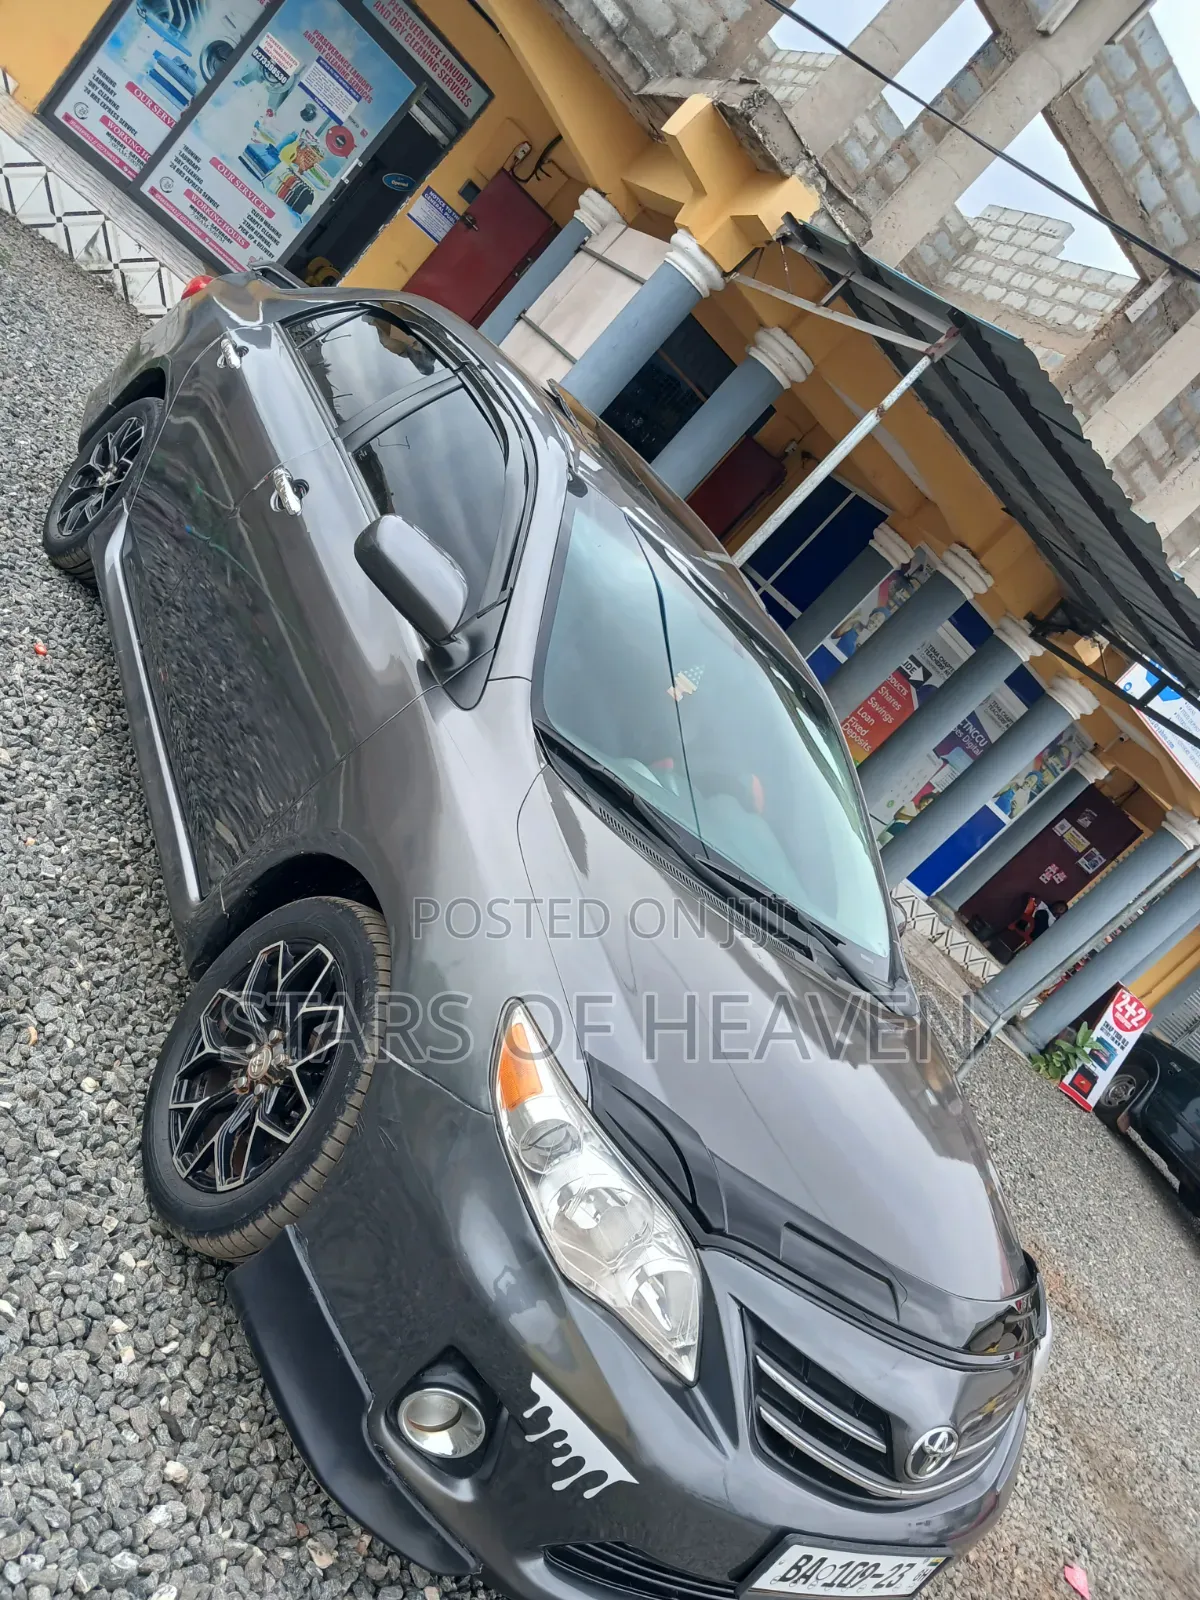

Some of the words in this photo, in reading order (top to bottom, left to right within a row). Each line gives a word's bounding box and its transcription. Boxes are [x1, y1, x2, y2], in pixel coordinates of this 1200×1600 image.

[387, 0, 443, 58] PERSEVERANCE
[265, 41, 273, 49] FOR
[311, 30, 352, 70] PERSEVERANCE
[373, 0, 393, 20] AND
[389, 17, 408, 36] DRY
[404, 33, 441, 73] CLEANING
[437, 69, 473, 108] SERVICES
[302, 30, 317, 45] AND
[313, 41, 327, 55] DRY
[324, 52, 351, 80] CLEANING
[347, 77, 375, 104] SERVICES
[97, 89, 121, 111] CLEANING
[133, 89, 154, 108] OUR
[99, 101, 120, 120] EXPRESS
[118, 118, 138, 136] SERVICE
[106, 120, 143, 154] WORKING
[106, 131, 127, 150] MONDAY
[182, 164, 204, 185] CLEANING
[184, 176, 203, 194] EXPRESS
[201, 192, 220, 209] SERVICE
[216, 163, 237, 183] OUR
[234, 180, 270, 214] SERVICES
[429, 192, 446, 207] NOTICE
[424, 194, 444, 212] GENERAL
[189, 194, 222, 224] WORKING
[219, 221, 247, 247] HOURS
[189, 204, 209, 223] MONDAY
[210, 223, 233, 245] SATURDAY
[262, 220, 283, 239] WASHING
[261, 228, 281, 246] CLEANING
[928, 644, 940, 657] TEMA
[902, 660, 916, 674] IDE
[878, 686, 902, 711] Shares
[992, 701, 1002, 712] TEMA
[857, 707, 876, 726] Loan
[867, 697, 894, 725] Savings
[840, 723, 872, 753] Deposits
[848, 717, 868, 737] Fixed
[961, 735, 983, 757] Digital
[1114, 992, 1148, 1028] 2+2
